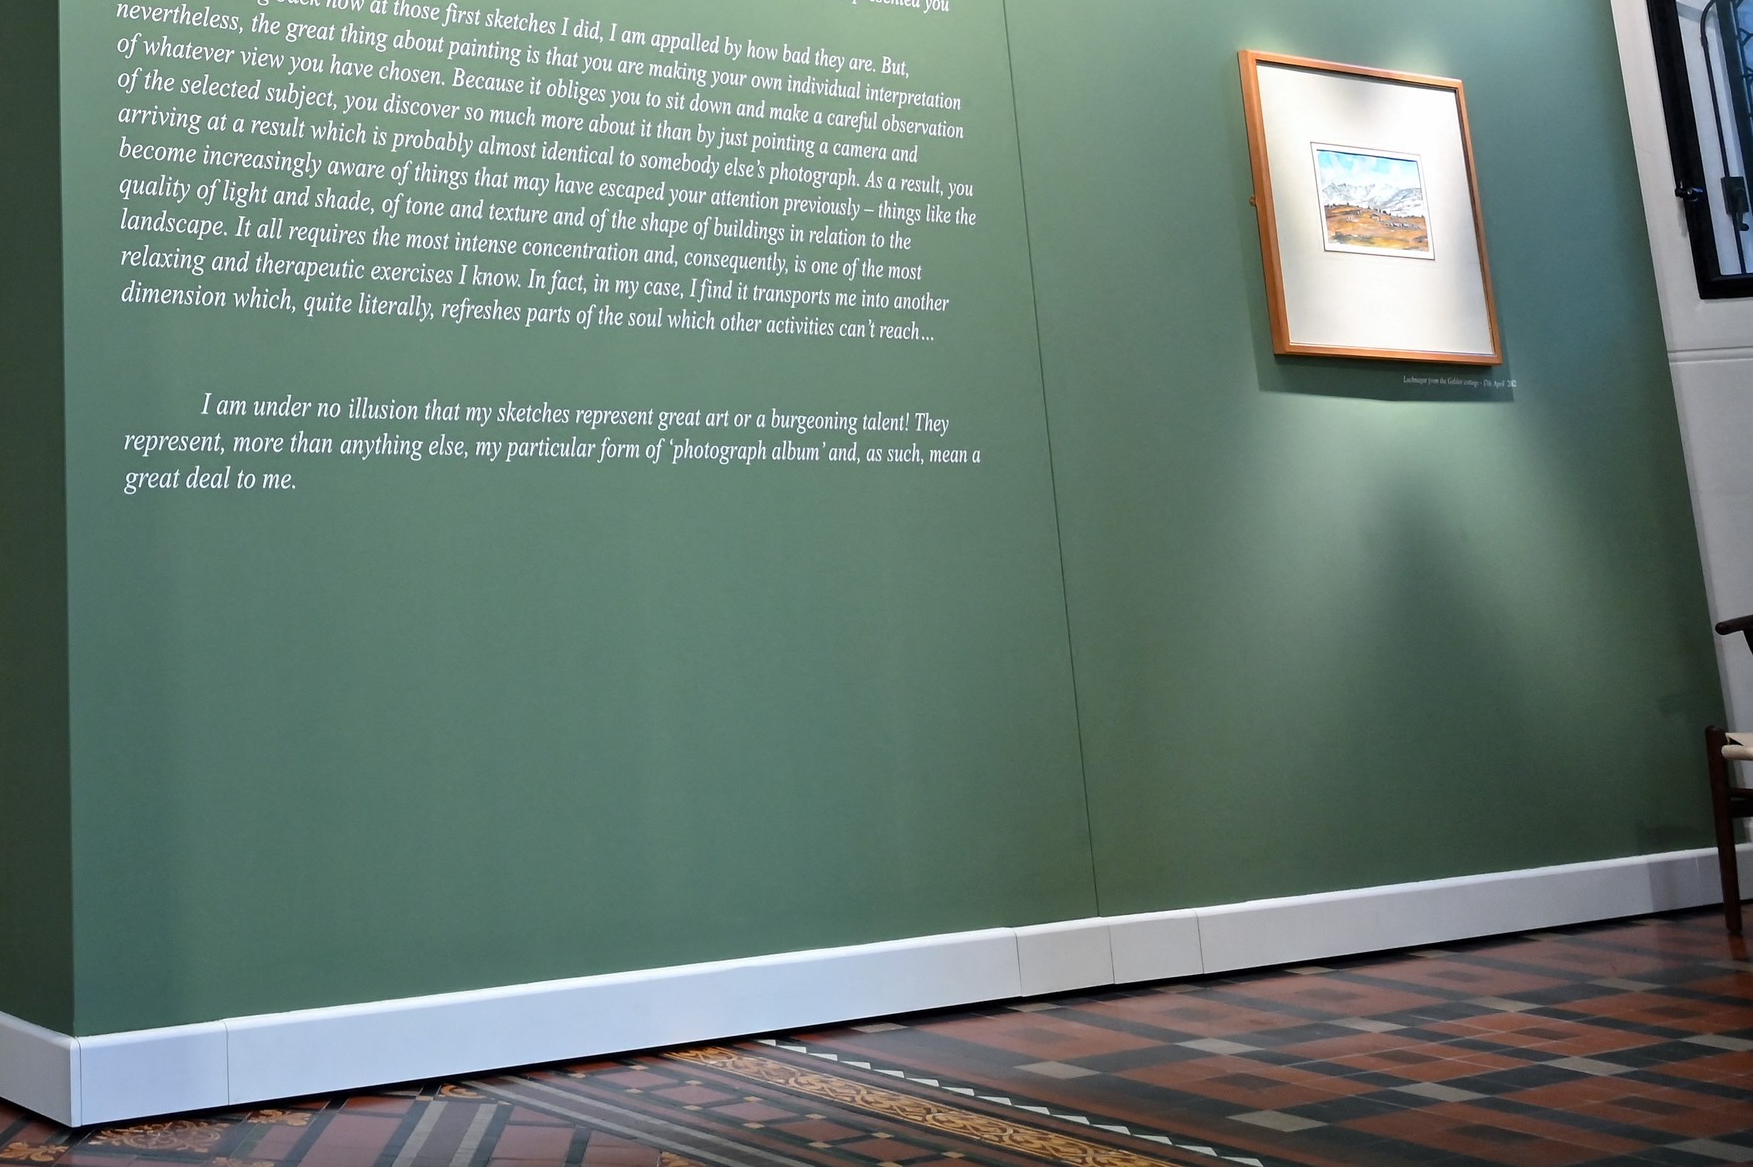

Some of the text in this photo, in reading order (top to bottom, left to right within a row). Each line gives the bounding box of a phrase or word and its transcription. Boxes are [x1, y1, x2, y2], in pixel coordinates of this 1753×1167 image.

[442, 3, 481, 27] first
[485, 8, 556, 34] sketches
[561, 17, 569, 36] I
[573, 19, 603, 43] did,
[609, 23, 617, 41] I
[621, 30, 646, 45] am
[651, 33, 719, 54] appalled
[724, 37, 742, 61] by
[747, 40, 778, 60] how
[783, 44, 810, 64] bad
[815, 48, 845, 73] they
[849, 58, 875, 72] are.
[881, 56, 909, 78] But,
[117, 33, 963, 138] of whatever view you have chosen. Because it obliges you to sit down and make a careful observation
[119, 136, 196, 163] become
[203, 145, 322, 178] increasingly
[328, 161, 385, 178] aware
[391, 160, 412, 186] of
[415, 162, 468, 190] things
[475, 167, 509, 188] that
[514, 176, 549, 196] may
[555, 173, 594, 195] have
[599, 182, 665, 204] escaped
[668, 189, 706, 206] your
[711, 190, 779, 210] attention
[782, 196, 860, 221] previously
[879, 200, 921, 225] things
[926, 204, 951, 223] like
[956, 207, 976, 225] the
[121, 245, 949, 311] relaxing and therapeutic exercises I know. In fact, in my case, I find it transports me into another
[124, 465, 295, 494] great deal to me.
